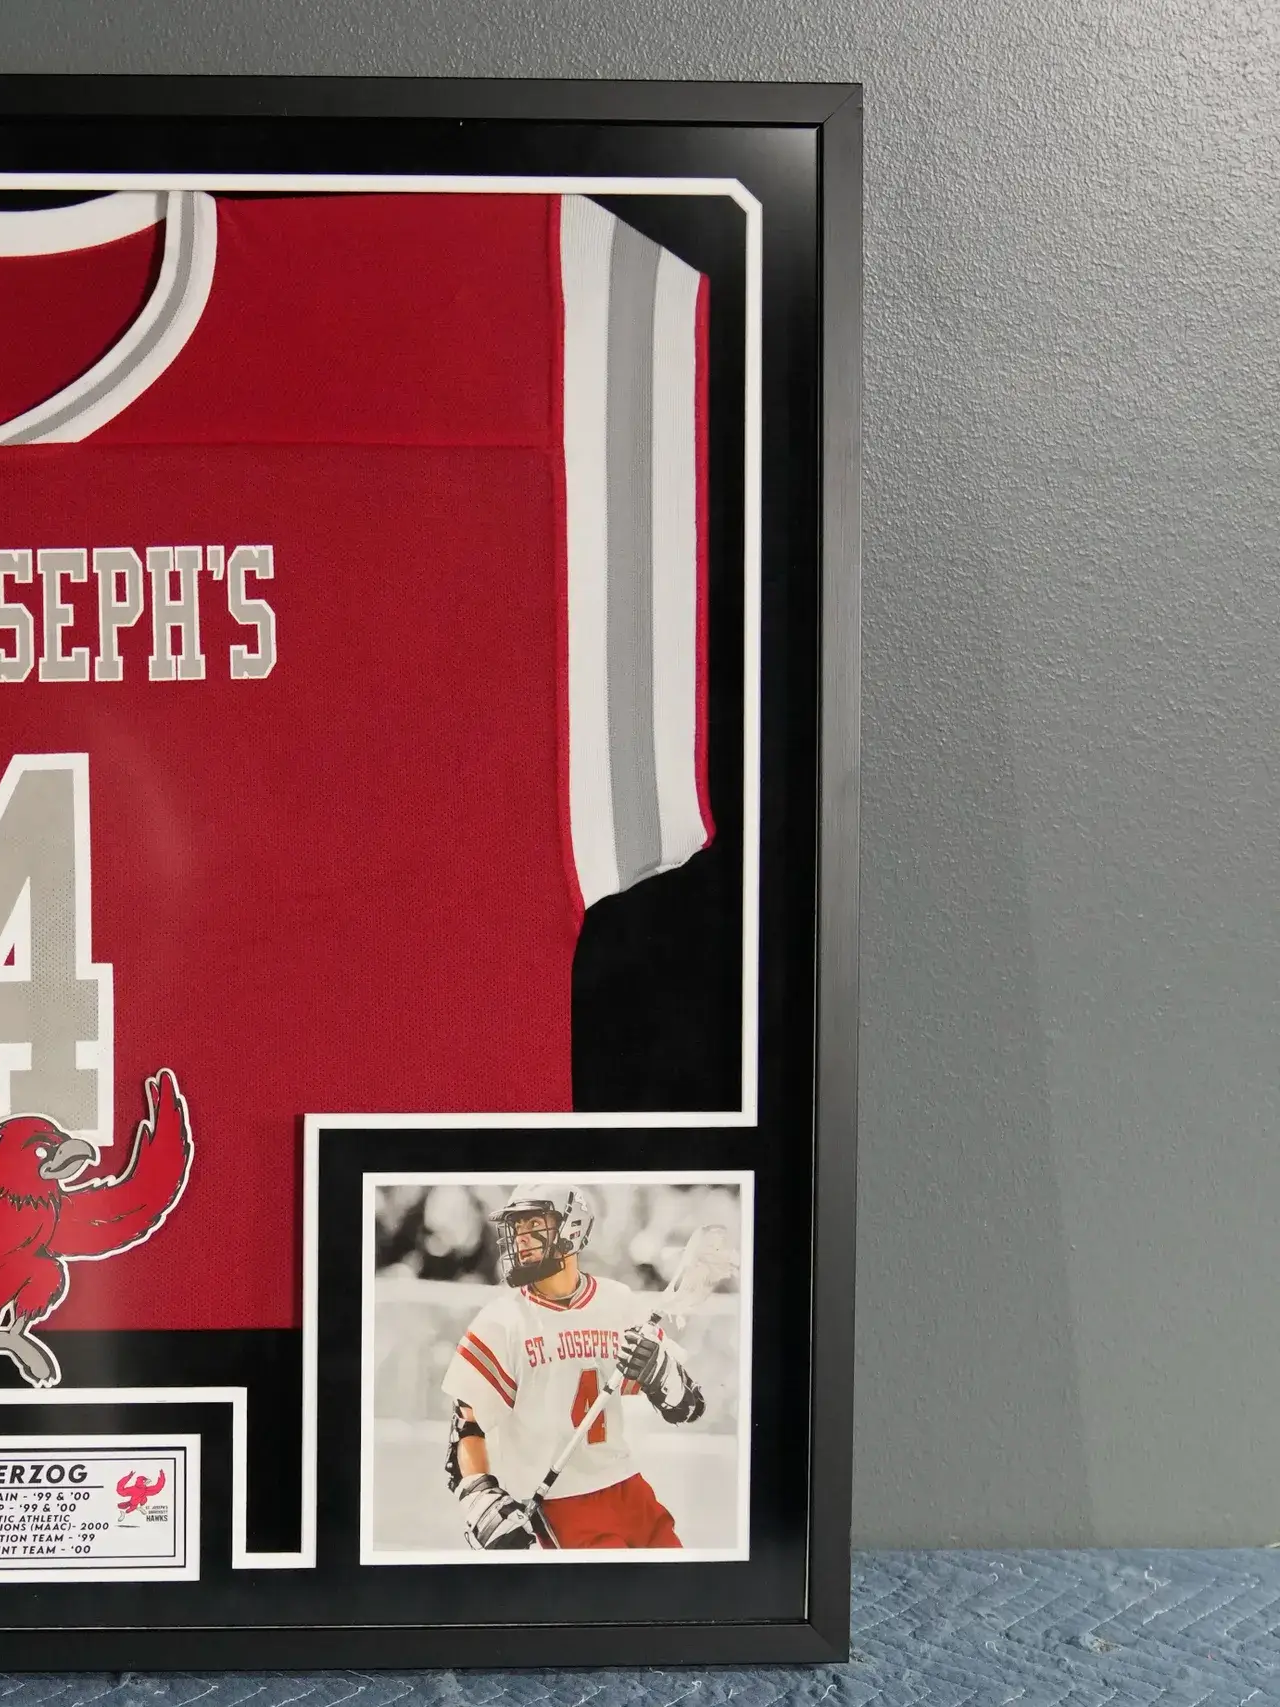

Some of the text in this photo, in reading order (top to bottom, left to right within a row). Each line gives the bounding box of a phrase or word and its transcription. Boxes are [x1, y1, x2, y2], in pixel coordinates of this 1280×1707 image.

[524, 1329, 619, 1368] ST. JOSEPH'S
[56, 1492, 64, 1501] &
[43, 1504, 50, 1512] &
[20, 1514, 70, 1523] ATHLETIC
[80, 1522, 109, 1530] 2000
[33, 1534, 64, 1542] TEAM
[23, 1546, 56, 1554] TEAM
